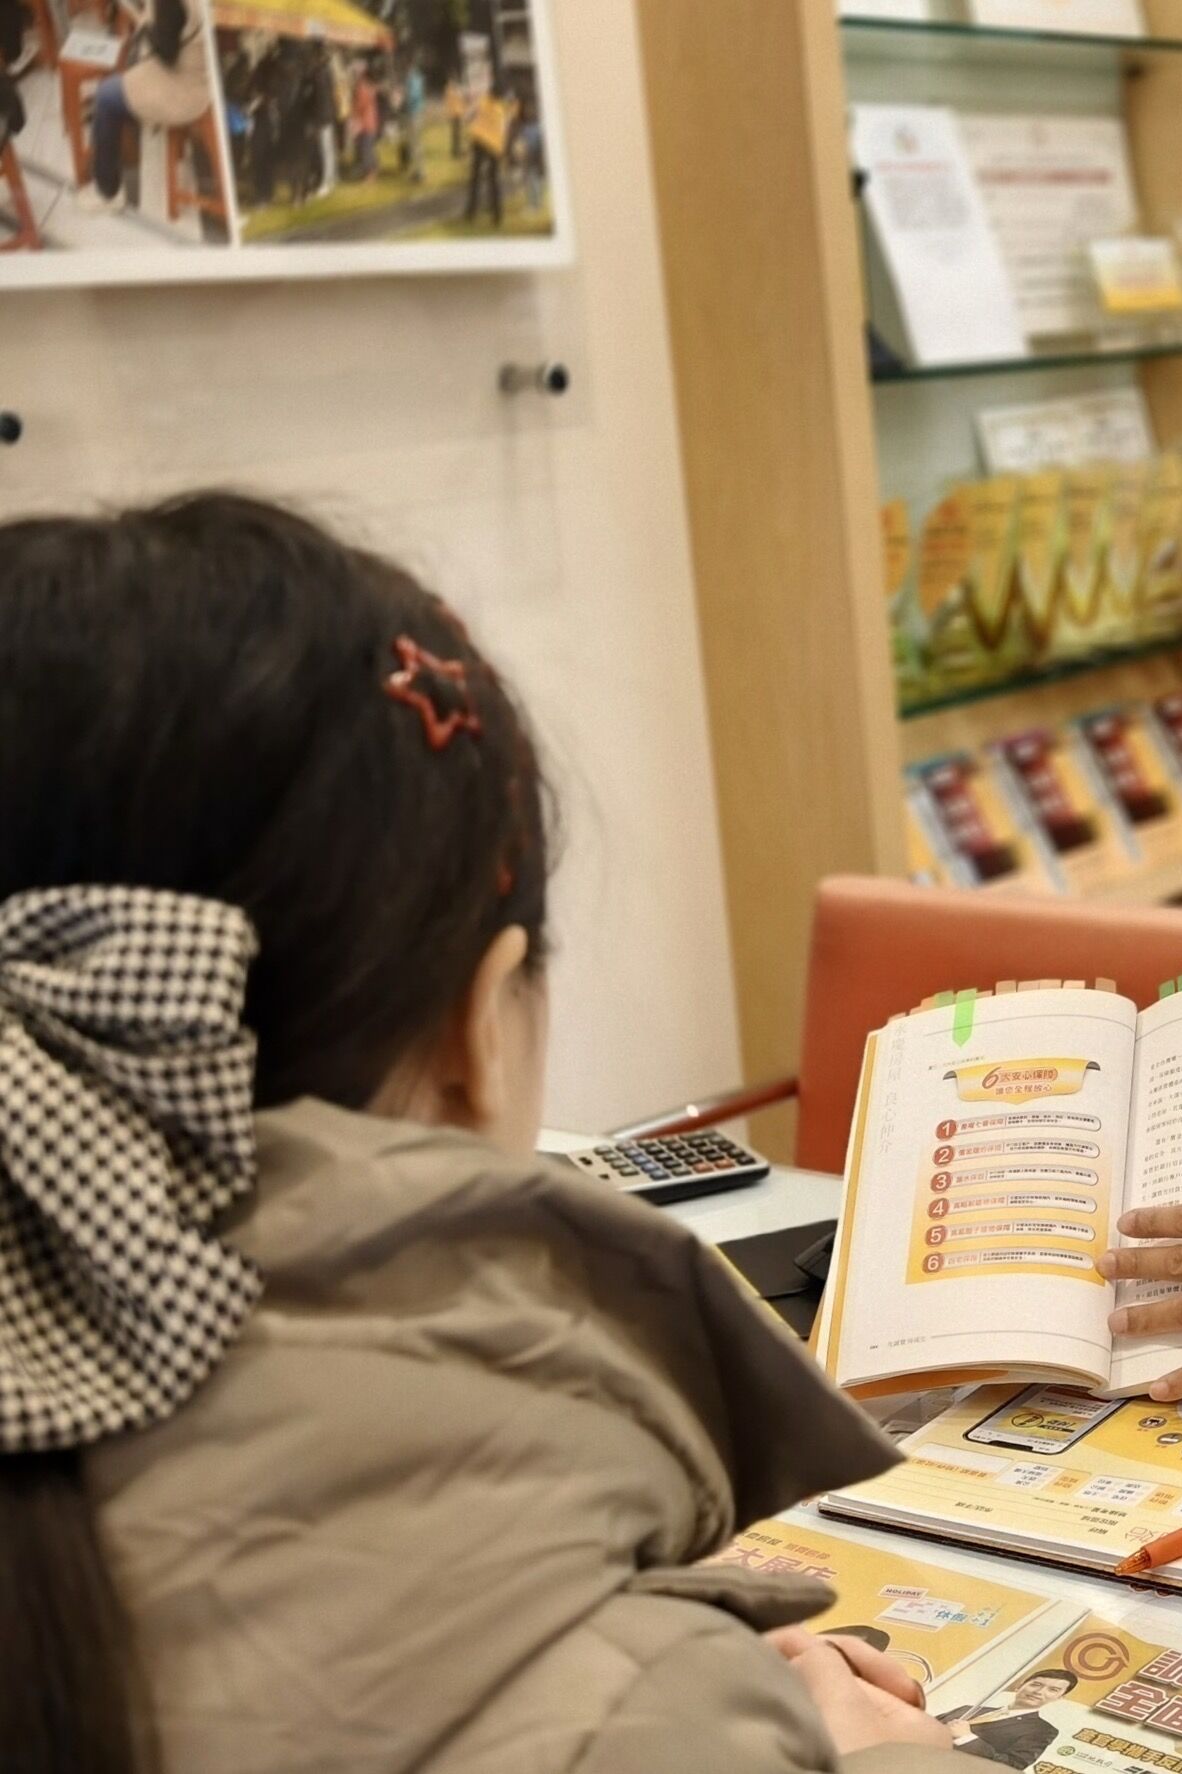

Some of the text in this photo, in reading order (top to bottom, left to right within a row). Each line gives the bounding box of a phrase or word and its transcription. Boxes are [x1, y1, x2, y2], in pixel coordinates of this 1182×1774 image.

[943, 1122, 951, 1137] 1
[938, 1149, 950, 1163] 2
[935, 1175, 947, 1189] 3
[932, 1201, 944, 1215] 4
[930, 1228, 942, 1243] 5
[927, 1255, 939, 1270] 6
[744, 1532, 783, 1546] 慶房屋
[885, 1588, 922, 1597] HOLIDAY
